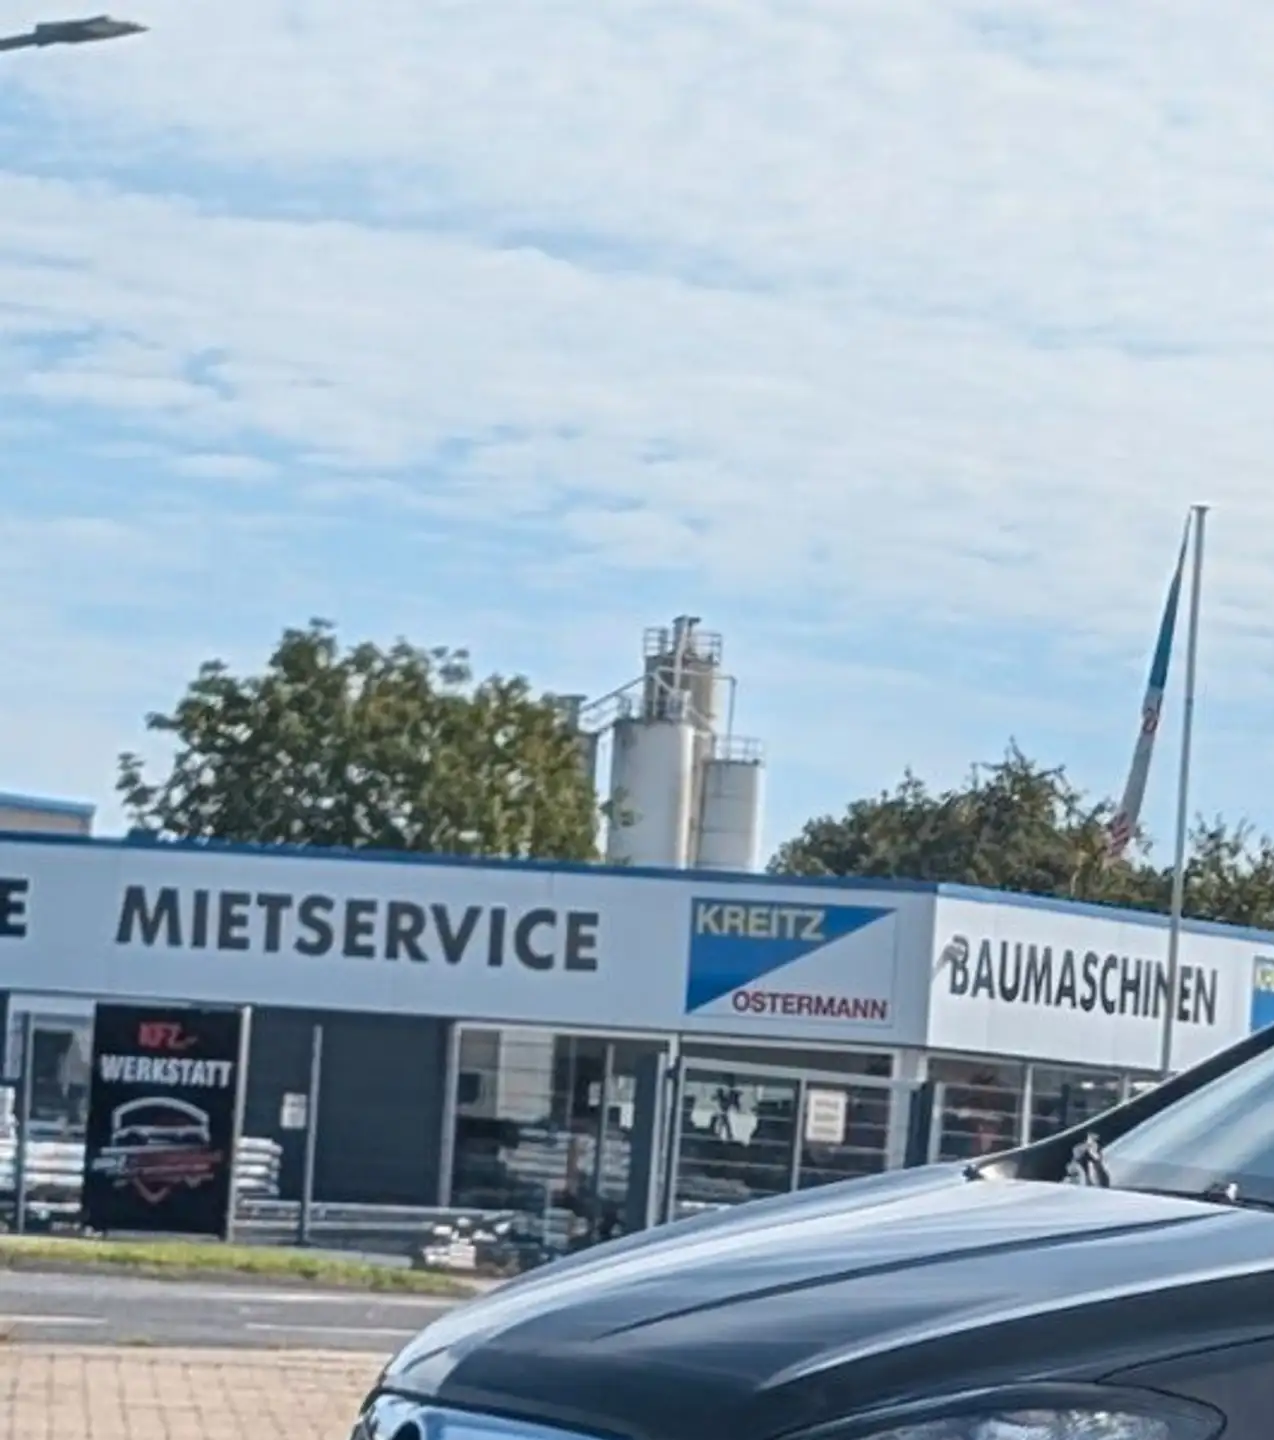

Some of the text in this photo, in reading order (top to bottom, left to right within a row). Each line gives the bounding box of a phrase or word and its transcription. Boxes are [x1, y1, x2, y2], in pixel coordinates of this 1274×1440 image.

[116, 885, 599, 971] MIETSERVICE
[696, 903, 825, 941] KREITZ
[949, 935, 1218, 1025] BAUMASCHINEN
[732, 990, 887, 1020] OSTERMANN
[101, 1054, 232, 1088] WERKSTATT
